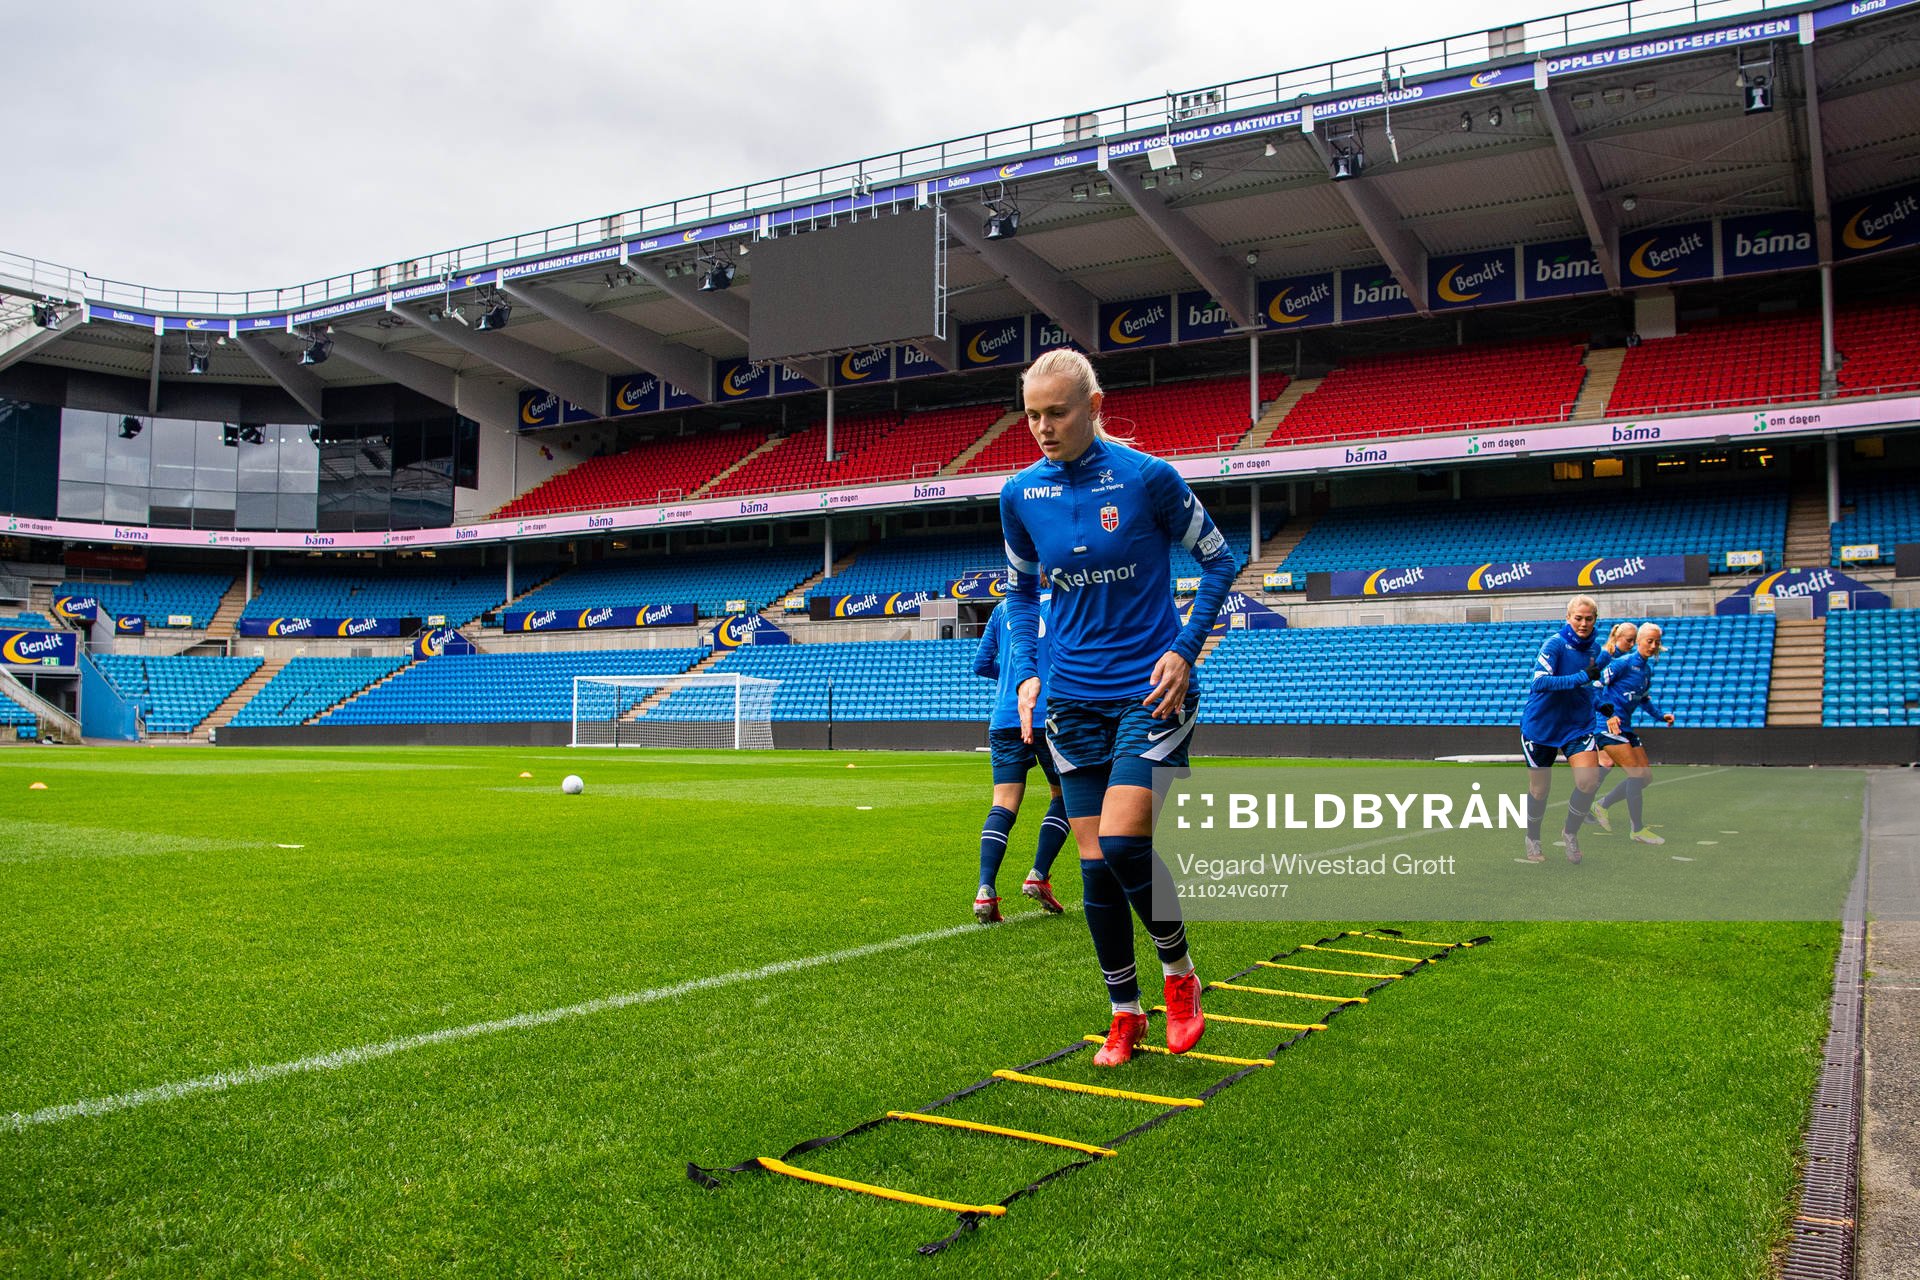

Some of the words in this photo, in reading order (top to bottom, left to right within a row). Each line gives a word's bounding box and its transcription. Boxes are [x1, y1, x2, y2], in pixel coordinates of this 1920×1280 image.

[1547, 50, 1616, 73] OPPLEV
[1618, 19, 1790, 60] BENDIT-EFFEKTEN
[1109, 141, 1142, 156] SUNT
[1143, 128, 1211, 149] KOSTHOLD
[1213, 123, 1232, 136] OG
[1234, 111, 1301, 133] AKTIVITET
[1313, 103, 1338, 117] GIR
[1339, 86, 1424, 112] OVERSKUDD
[1862, 195, 1920, 236] Bendit
[1649, 232, 1704, 267] Bendit
[503, 264, 538, 277] OPPLEV
[538, 246, 620, 272] BENDIT-EFFEKTEN
[1455, 259, 1505, 291] Bendit
[294, 311, 311, 322] SUNT
[312, 303, 345, 318] KOSTHOLD
[345, 302, 356, 311] OG
[356, 294, 387, 308] AKTIVITET
[392, 290, 404, 300] GIR
[404, 283, 446, 298] OVERSKUDD
[1285, 283, 1331, 313] Bendit
[1124, 305, 1166, 334] Bendit
[980, 326, 1018, 354] Bendit
[854, 348, 887, 372] Bendit
[734, 362, 765, 387] Bendit
[626, 379, 656, 403] Bendit
[532, 393, 558, 418] Bendit
[1770, 417, 1786, 426] om
[1788, 414, 1821, 426] dagen
[1482, 440, 1497, 449] om
[1498, 437, 1526, 450] dagen
[1232, 461, 1245, 470] om
[1246, 458, 1271, 470] dagen
[829, 496, 840, 504] om
[840, 494, 859, 504] dagen
[1024, 486, 1050, 500] KIWI
[676, 509, 692, 519] dagen
[19, 522, 31, 530] om
[31, 523, 53, 532] dagen
[1065, 562, 1137, 588] telenor
[1380, 567, 1425, 594] Bendit
[1484, 562, 1532, 589] Bendit
[1596, 556, 1646, 585] Bendit
[958, 580, 979, 593] Bendit
[1775, 569, 1836, 599] Bendit
[66, 597, 97, 612] Bendit
[847, 594, 878, 615] Bendit
[896, 591, 929, 613] Bendit
[348, 617, 378, 635] Bendit
[532, 610, 557, 629] Bendit
[587, 607, 613, 627] Bendit
[645, 604, 673, 625] Bendit
[280, 618, 312, 635] Bendit
[730, 615, 762, 638] Bendit
[20, 633, 63, 656] Bendit
[430, 628, 455, 649] Bendit
